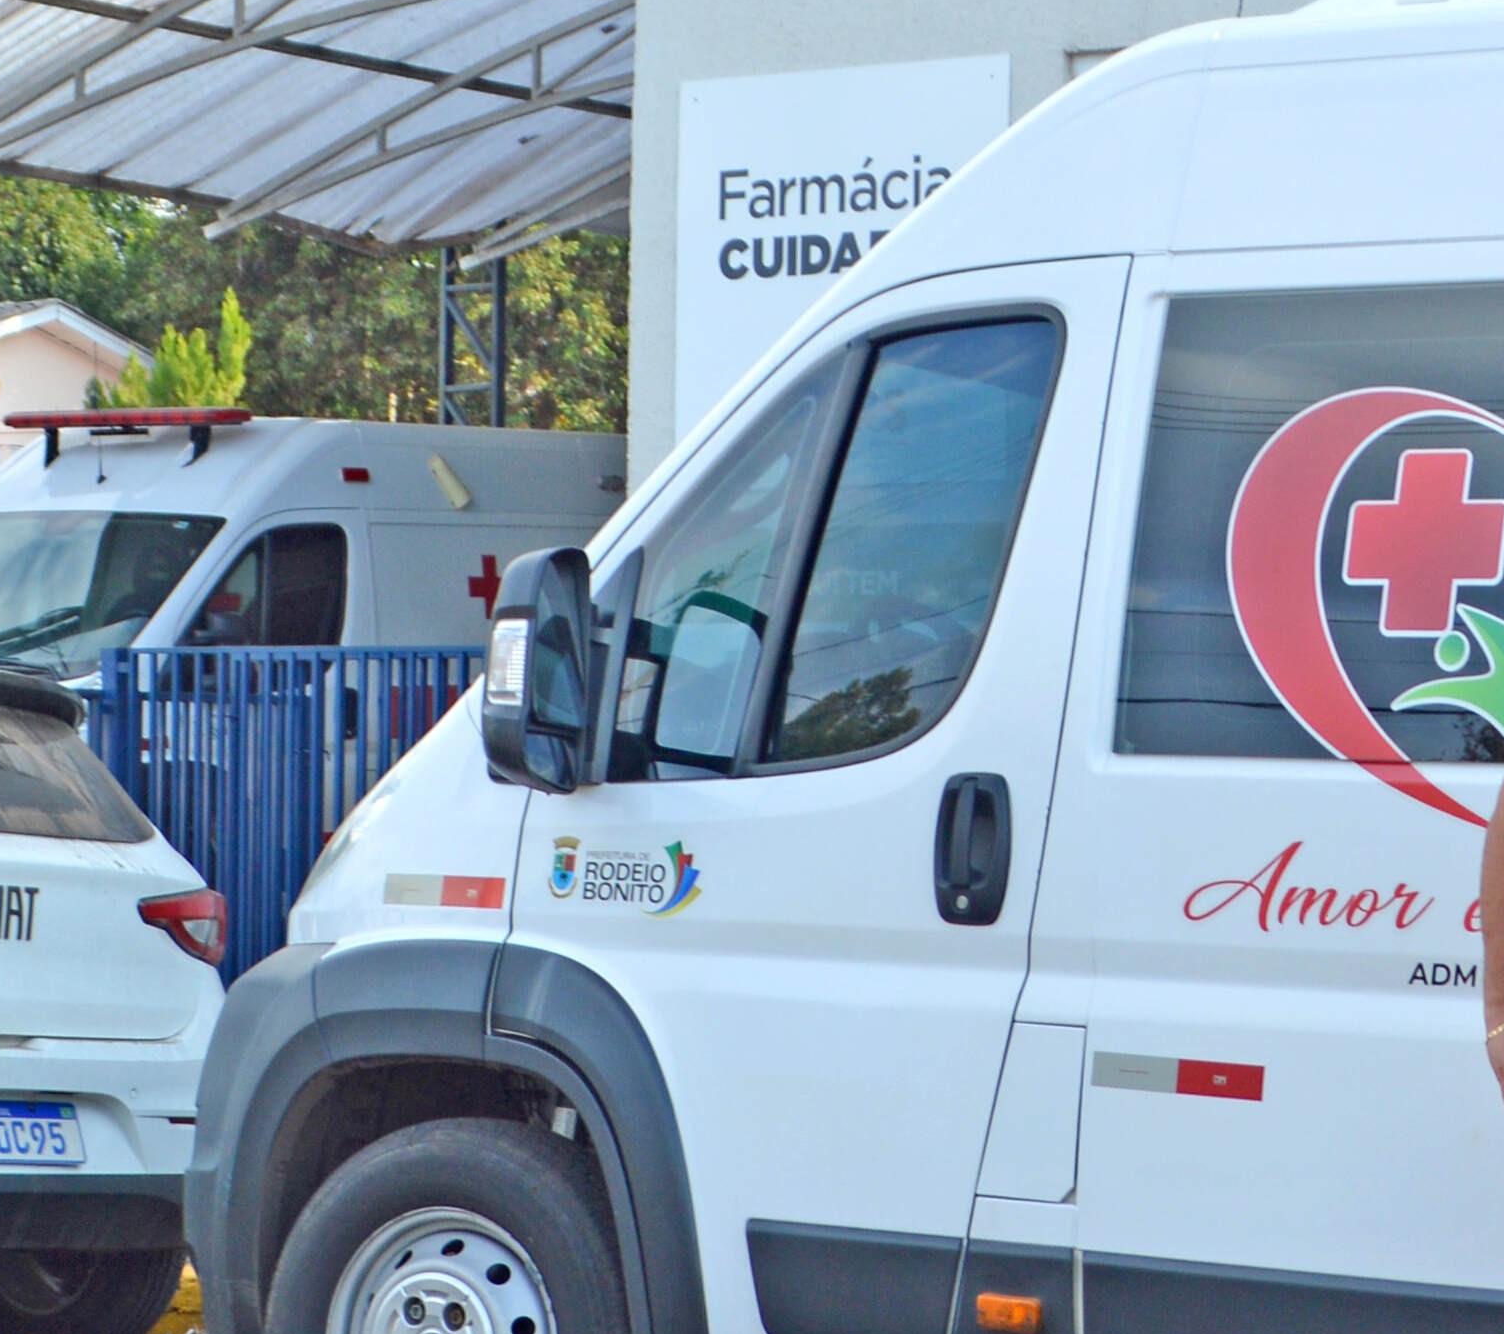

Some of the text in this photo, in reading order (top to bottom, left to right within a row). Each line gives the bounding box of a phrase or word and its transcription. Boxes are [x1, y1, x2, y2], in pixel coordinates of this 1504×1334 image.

[586, 850, 650, 861] PREFEITURA DE
[584, 861, 666, 884] RODEIO
[583, 881, 665, 904] BONITO
[1182, 840, 1435, 933] Amor
[1408, 962, 1478, 988] ADM
